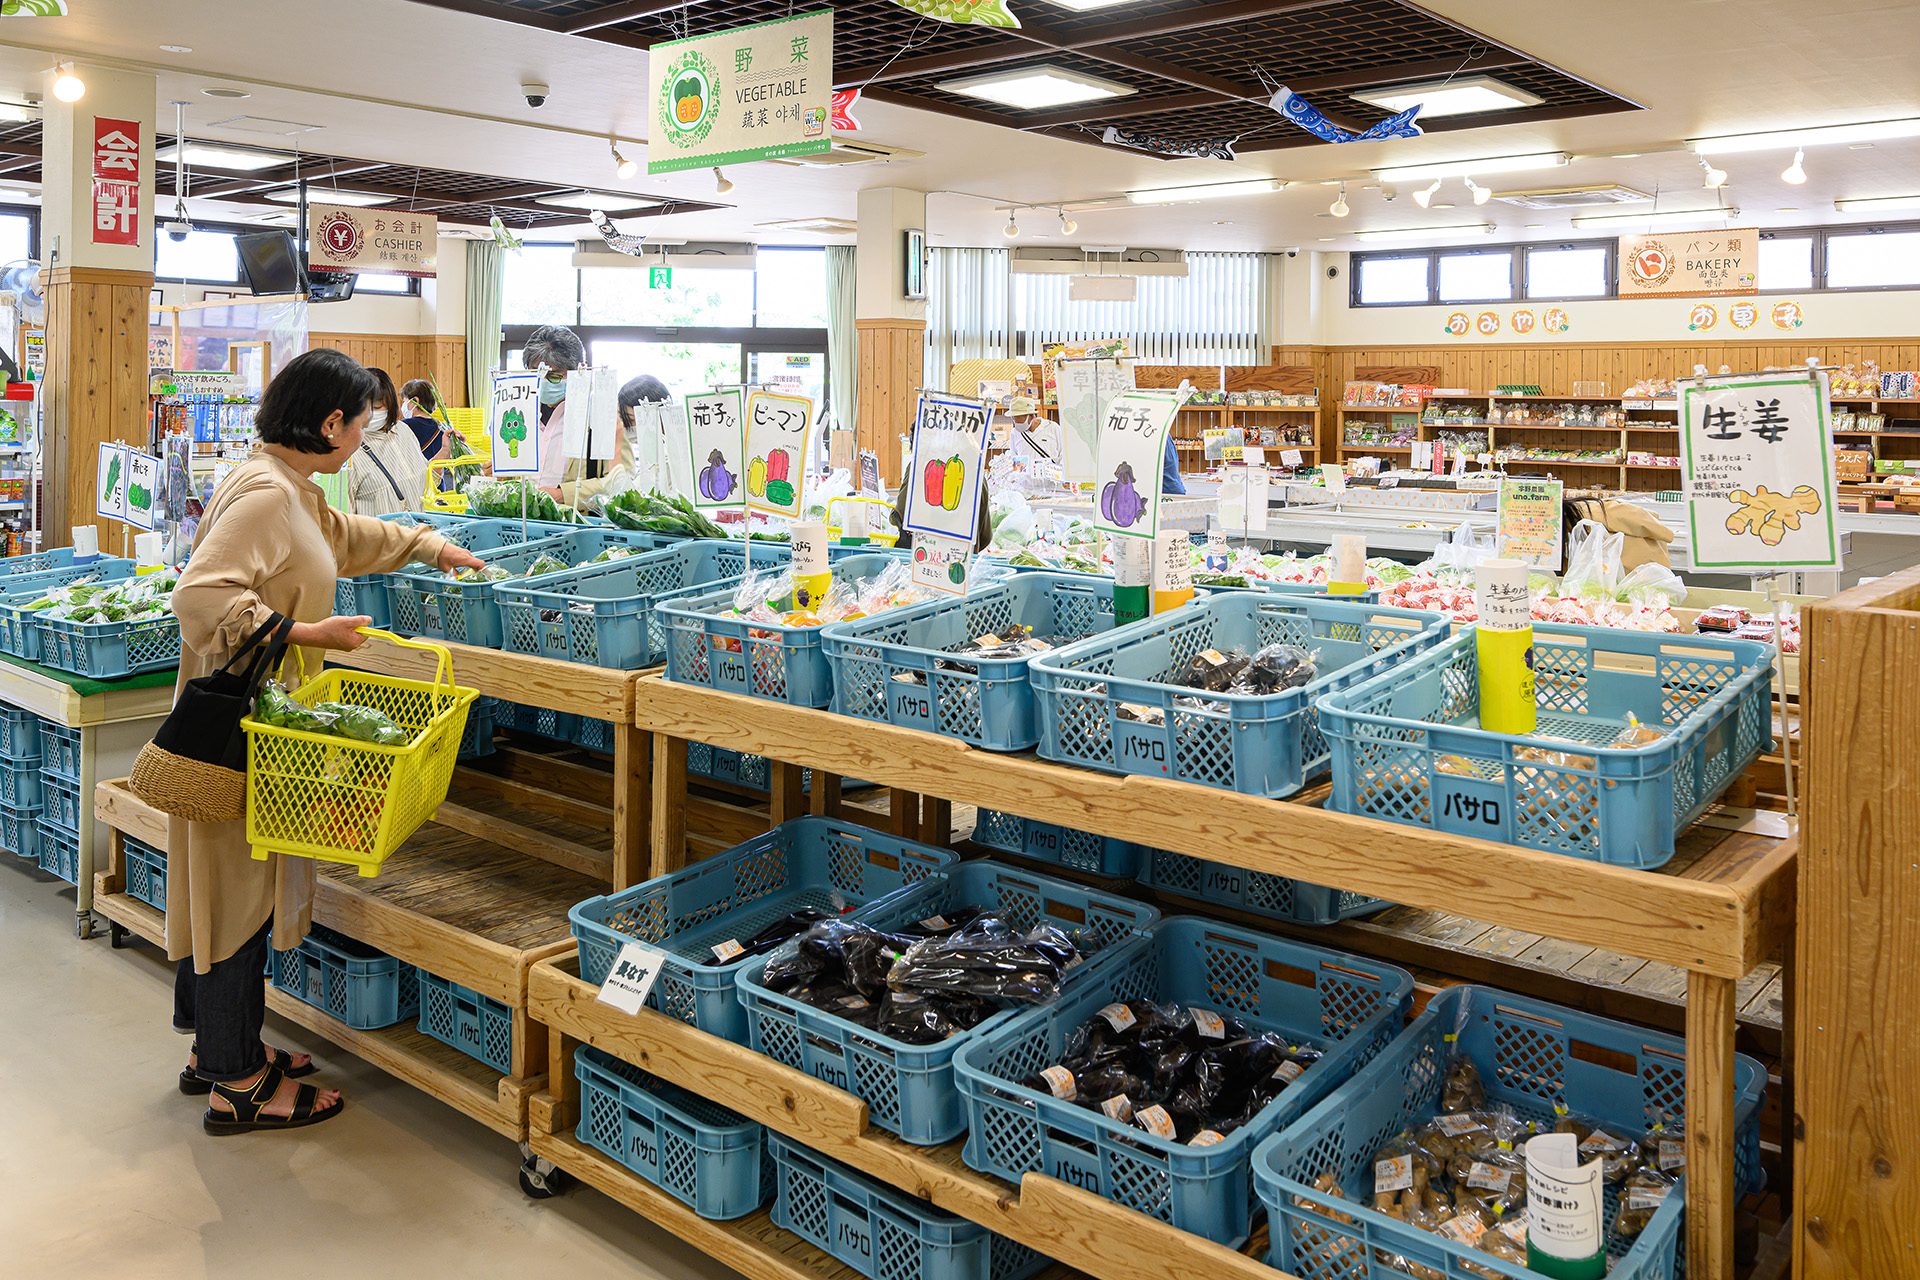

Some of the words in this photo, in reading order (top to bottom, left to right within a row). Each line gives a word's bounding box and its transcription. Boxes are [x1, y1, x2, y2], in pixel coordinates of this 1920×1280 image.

[734, 36, 809, 74] 野菜
[736, 78, 807, 104] VEGETABLE
[741, 108, 769, 129] 蔬菜
[775, 102, 800, 124] 야채
[96, 130, 139, 235] 会計
[374, 219, 422, 235] お会計
[375, 238, 423, 251] CASHIER
[1685, 238, 1742, 253] パン類
[1686, 258, 1741, 271] BAKERY
[1449, 310, 1565, 334] おみやげ
[1692, 302, 1801, 330] お菓子
[494, 383, 537, 405] ブロッコリー
[922, 405, 985, 434] ぱぷりか
[1702, 398, 1790, 444] 生姜
[132, 458, 149, 477] 青じそ
[114, 484, 123, 510] にら
[1512, 493, 1550, 501] uno.farm
[546, 632, 567, 651] バサロ
[718, 661, 746, 683] バサロ
[897, 695, 930, 720] バサロ
[1124, 735, 1166, 762] バサロ
[716, 756, 736, 773] バサロ
[1444, 791, 1500, 826] バサロ
[1029, 829, 1057, 850] バサロ
[1207, 871, 1240, 894] バサロ
[460, 1023, 480, 1046] バサロ
[815, 1061, 848, 1091] バサロ
[630, 1136, 657, 1168] バサロ
[1056, 1160, 1100, 1194] バサロ
[839, 1222, 871, 1258] バサロ
